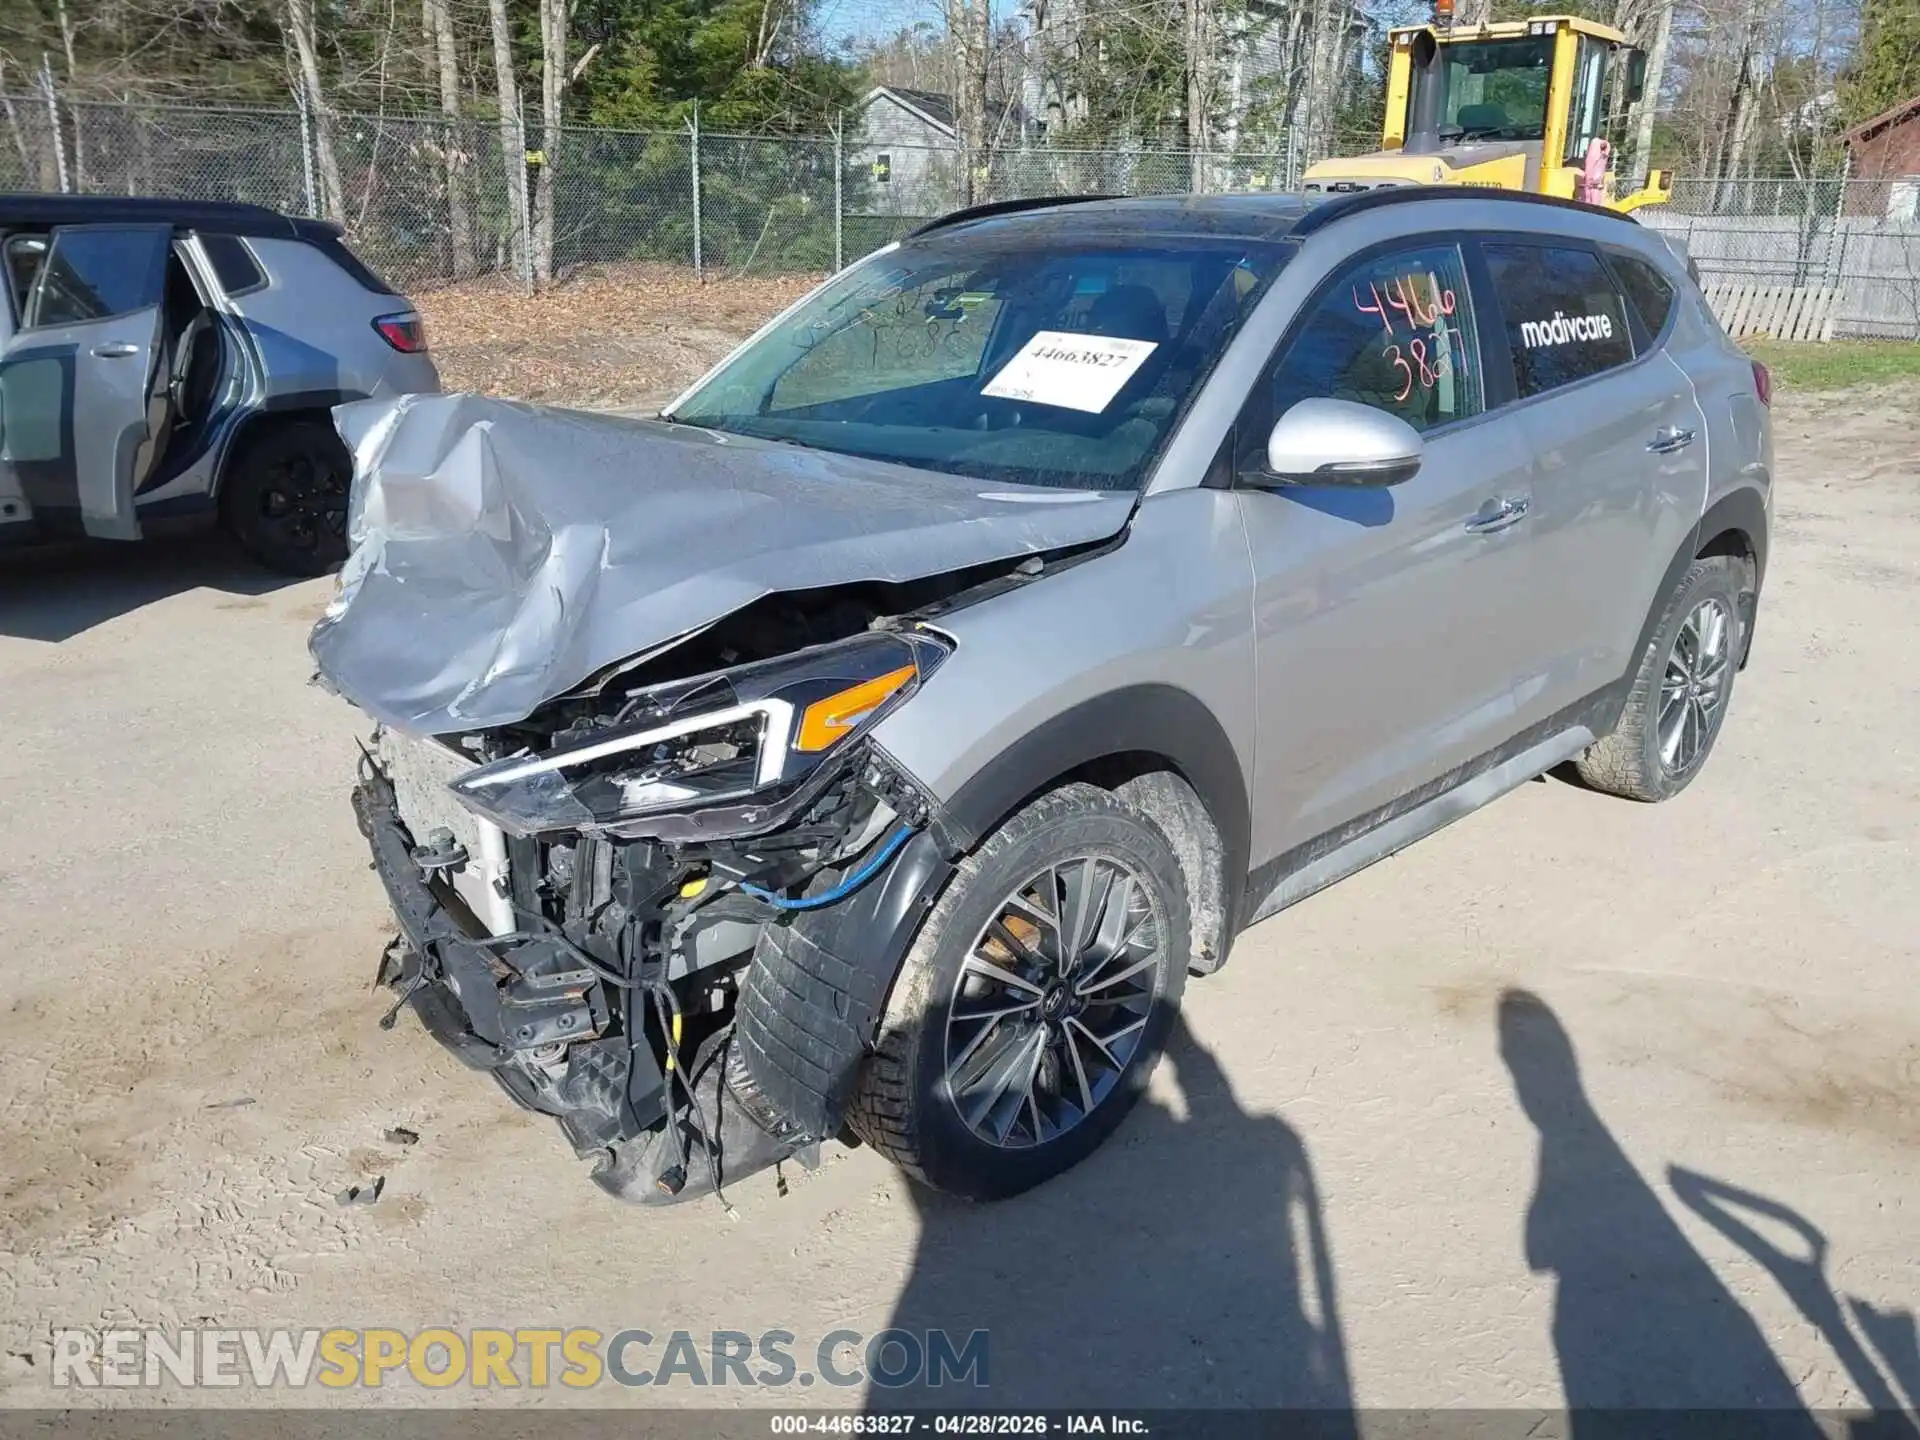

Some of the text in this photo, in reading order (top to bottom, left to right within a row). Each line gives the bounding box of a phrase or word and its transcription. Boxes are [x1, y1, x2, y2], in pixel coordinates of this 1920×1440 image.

[1352, 270, 1456, 336] 4466
[1030, 345, 1129, 368] 44663827
[1520, 311, 1613, 350] modivcare
[1382, 327, 1469, 401] 3827
